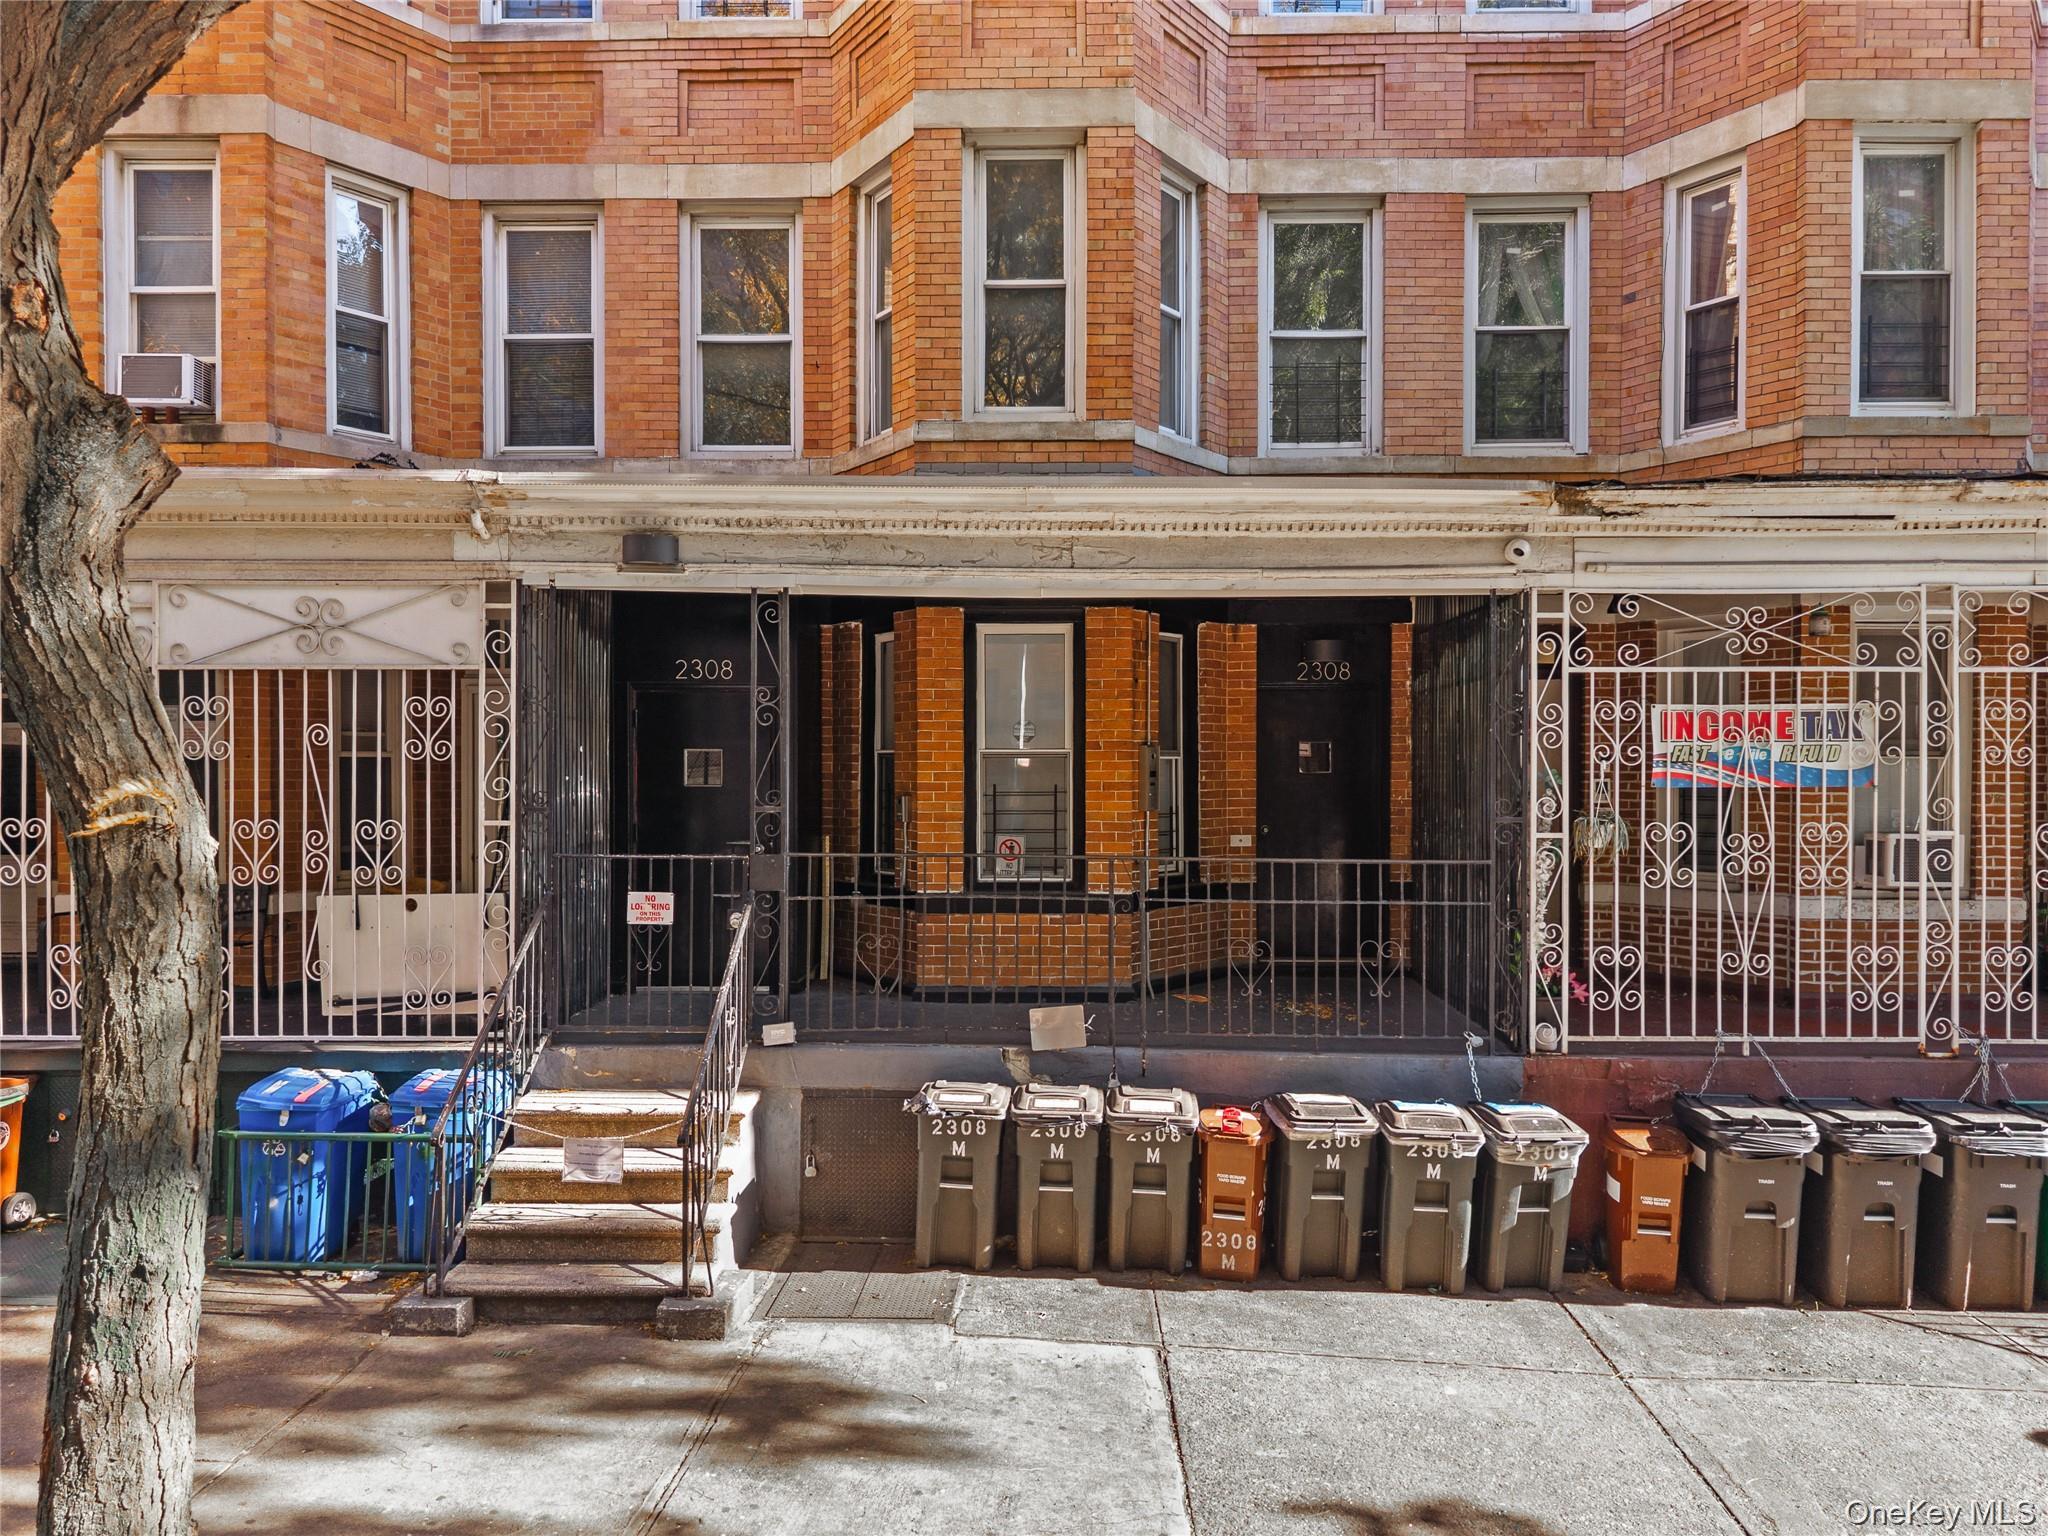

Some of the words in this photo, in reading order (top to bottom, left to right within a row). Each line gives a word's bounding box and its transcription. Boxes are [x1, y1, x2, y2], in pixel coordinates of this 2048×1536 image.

[675, 659, 733, 680] 2308
[1297, 662, 1351, 680] 2308
[1661, 709, 1796, 742] INCOME
[1800, 709, 1866, 742] TAX
[1671, 744, 1712, 762] FAST
[932, 1119, 986, 1135] 2308
[952, 1140, 966, 1157] M
[1050, 1143, 1064, 1159] M
[1146, 1147, 1160, 1164] M
[1406, 1142, 1463, 1158] 2308
[1515, 1145, 1569, 1160] 2308
[1326, 1154, 1341, 1170] M
[1426, 1163, 1441, 1180] M
[1533, 1166, 1548, 1182] M
[1202, 1230, 1256, 1251] 2308
[1221, 1253, 1235, 1271] M
